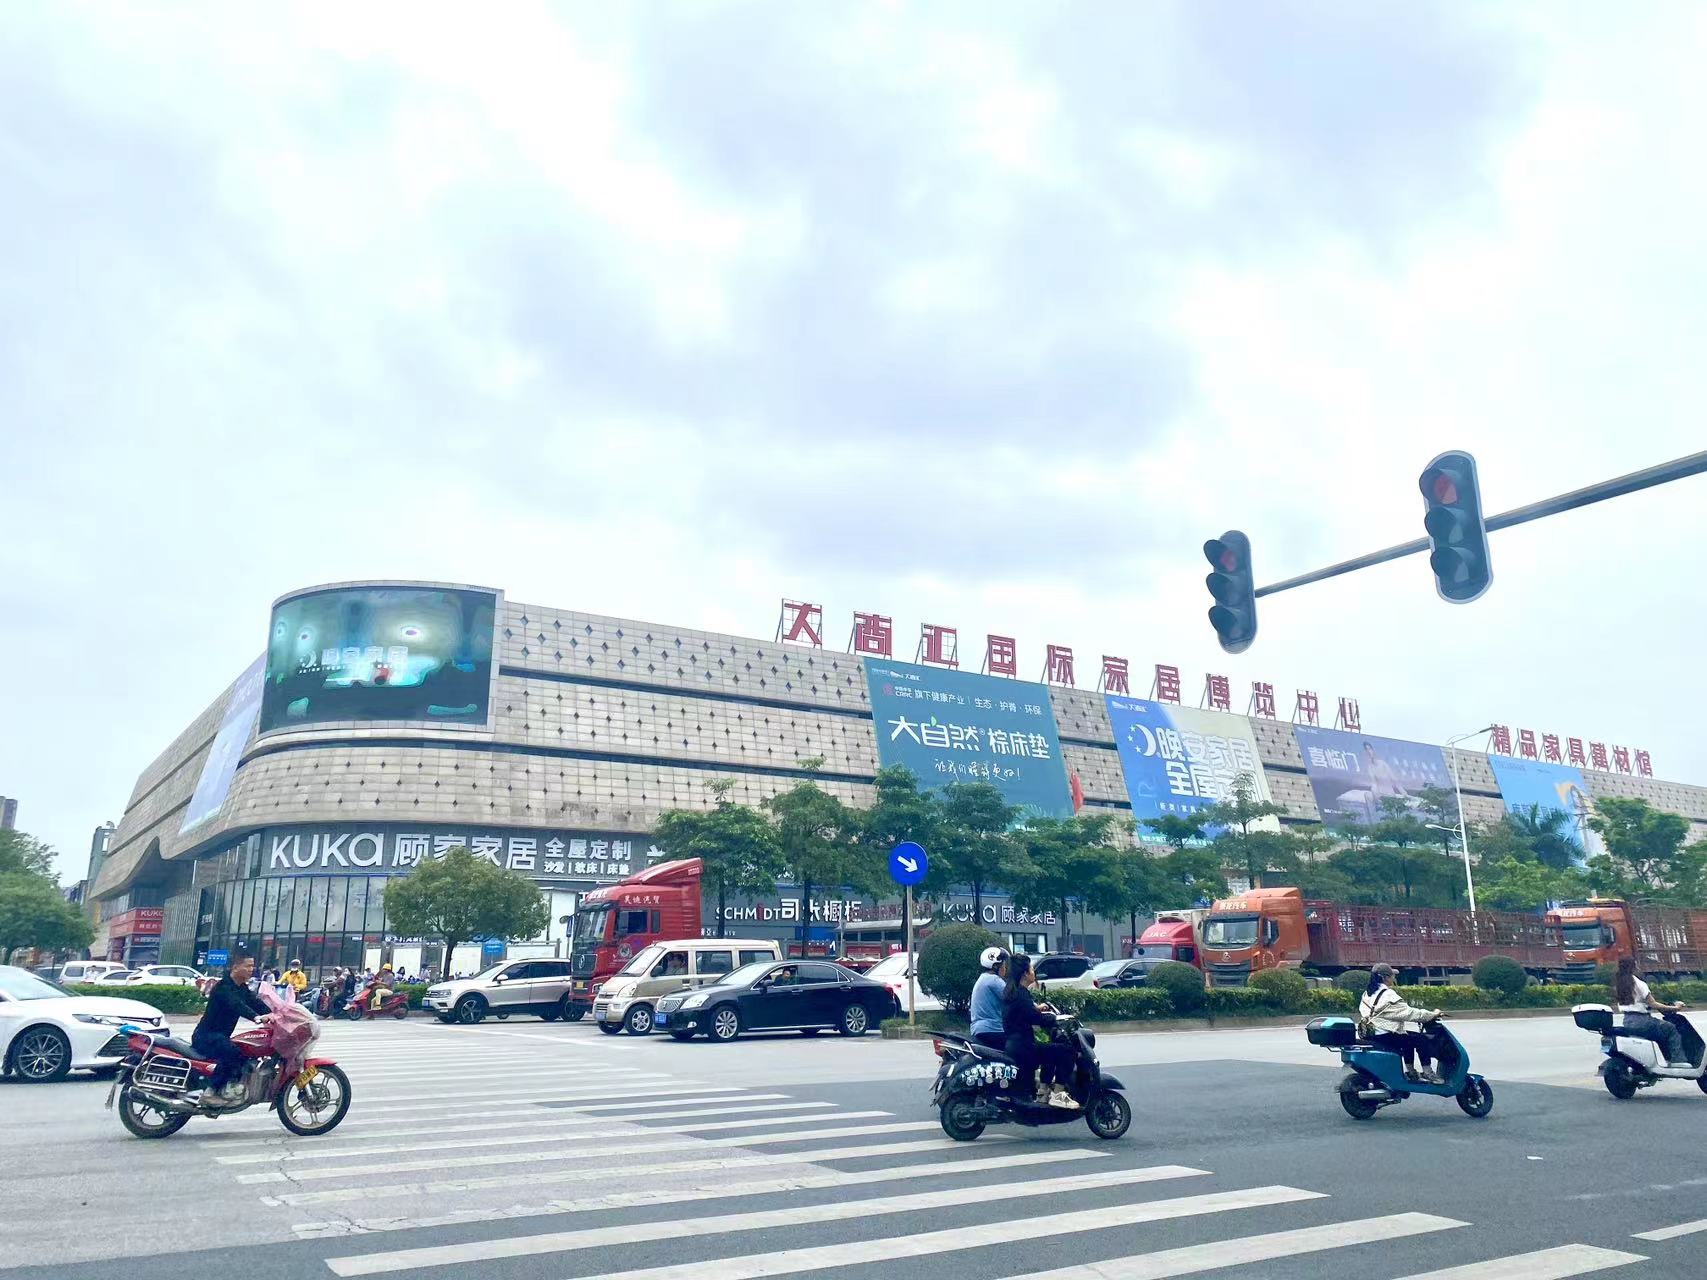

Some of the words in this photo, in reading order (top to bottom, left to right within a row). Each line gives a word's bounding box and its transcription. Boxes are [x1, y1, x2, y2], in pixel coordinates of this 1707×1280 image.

[783, 602, 1361, 731] 大商汇国际家居博览中心
[914, 688, 966, 706] 旗下健康产业
[887, 715, 981, 751] 大自然
[988, 727, 1051, 760] 棕床垫
[1155, 727, 1256, 771] 晚安家居
[1307, 746, 1360, 772] 喜临门
[1493, 725, 1653, 778] 精品家具建材馆
[392, 833, 538, 871] 顾家家居
[545, 837, 633, 863] 全屋定制
